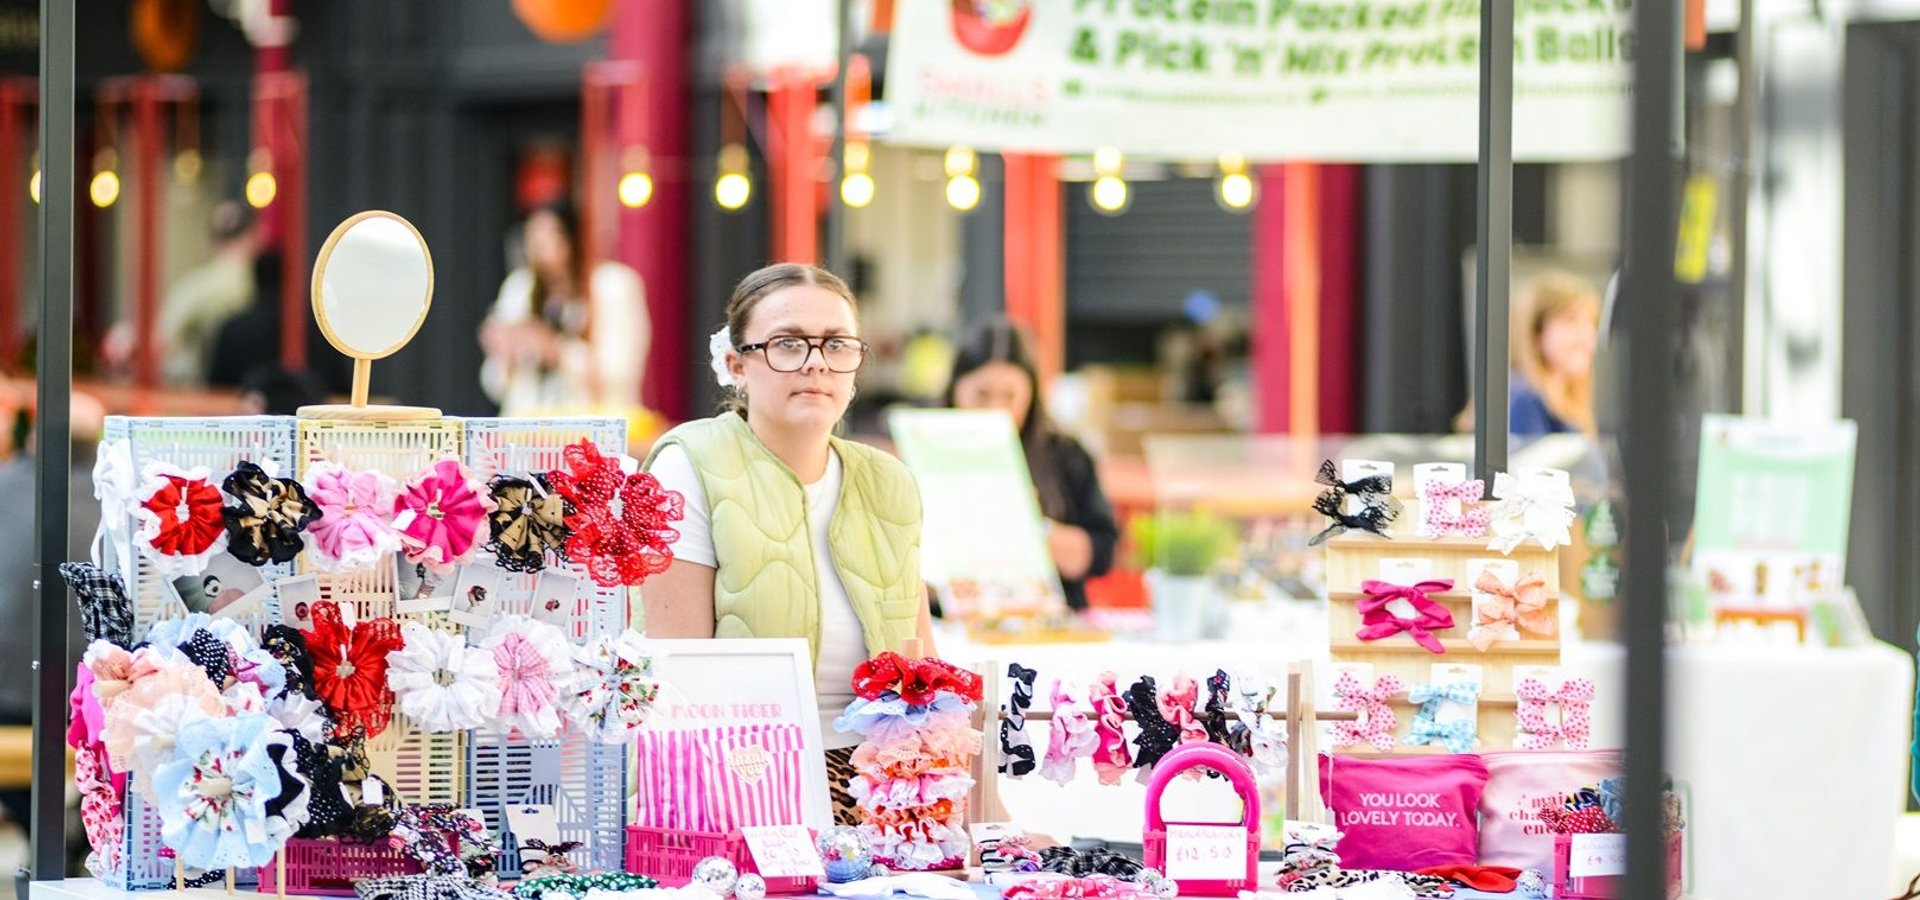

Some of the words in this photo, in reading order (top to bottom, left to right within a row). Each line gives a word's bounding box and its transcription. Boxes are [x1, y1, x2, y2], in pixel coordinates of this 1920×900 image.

[1069, 27, 1098, 62] &
[1114, 28, 1207, 71] Pick
[671, 703, 725, 719] MOON
[1359, 792, 1394, 807] YOU
[1395, 792, 1441, 808] LOOK
[1340, 811, 1399, 826] LOVELY
[1402, 811, 1462, 828] TODAY.
